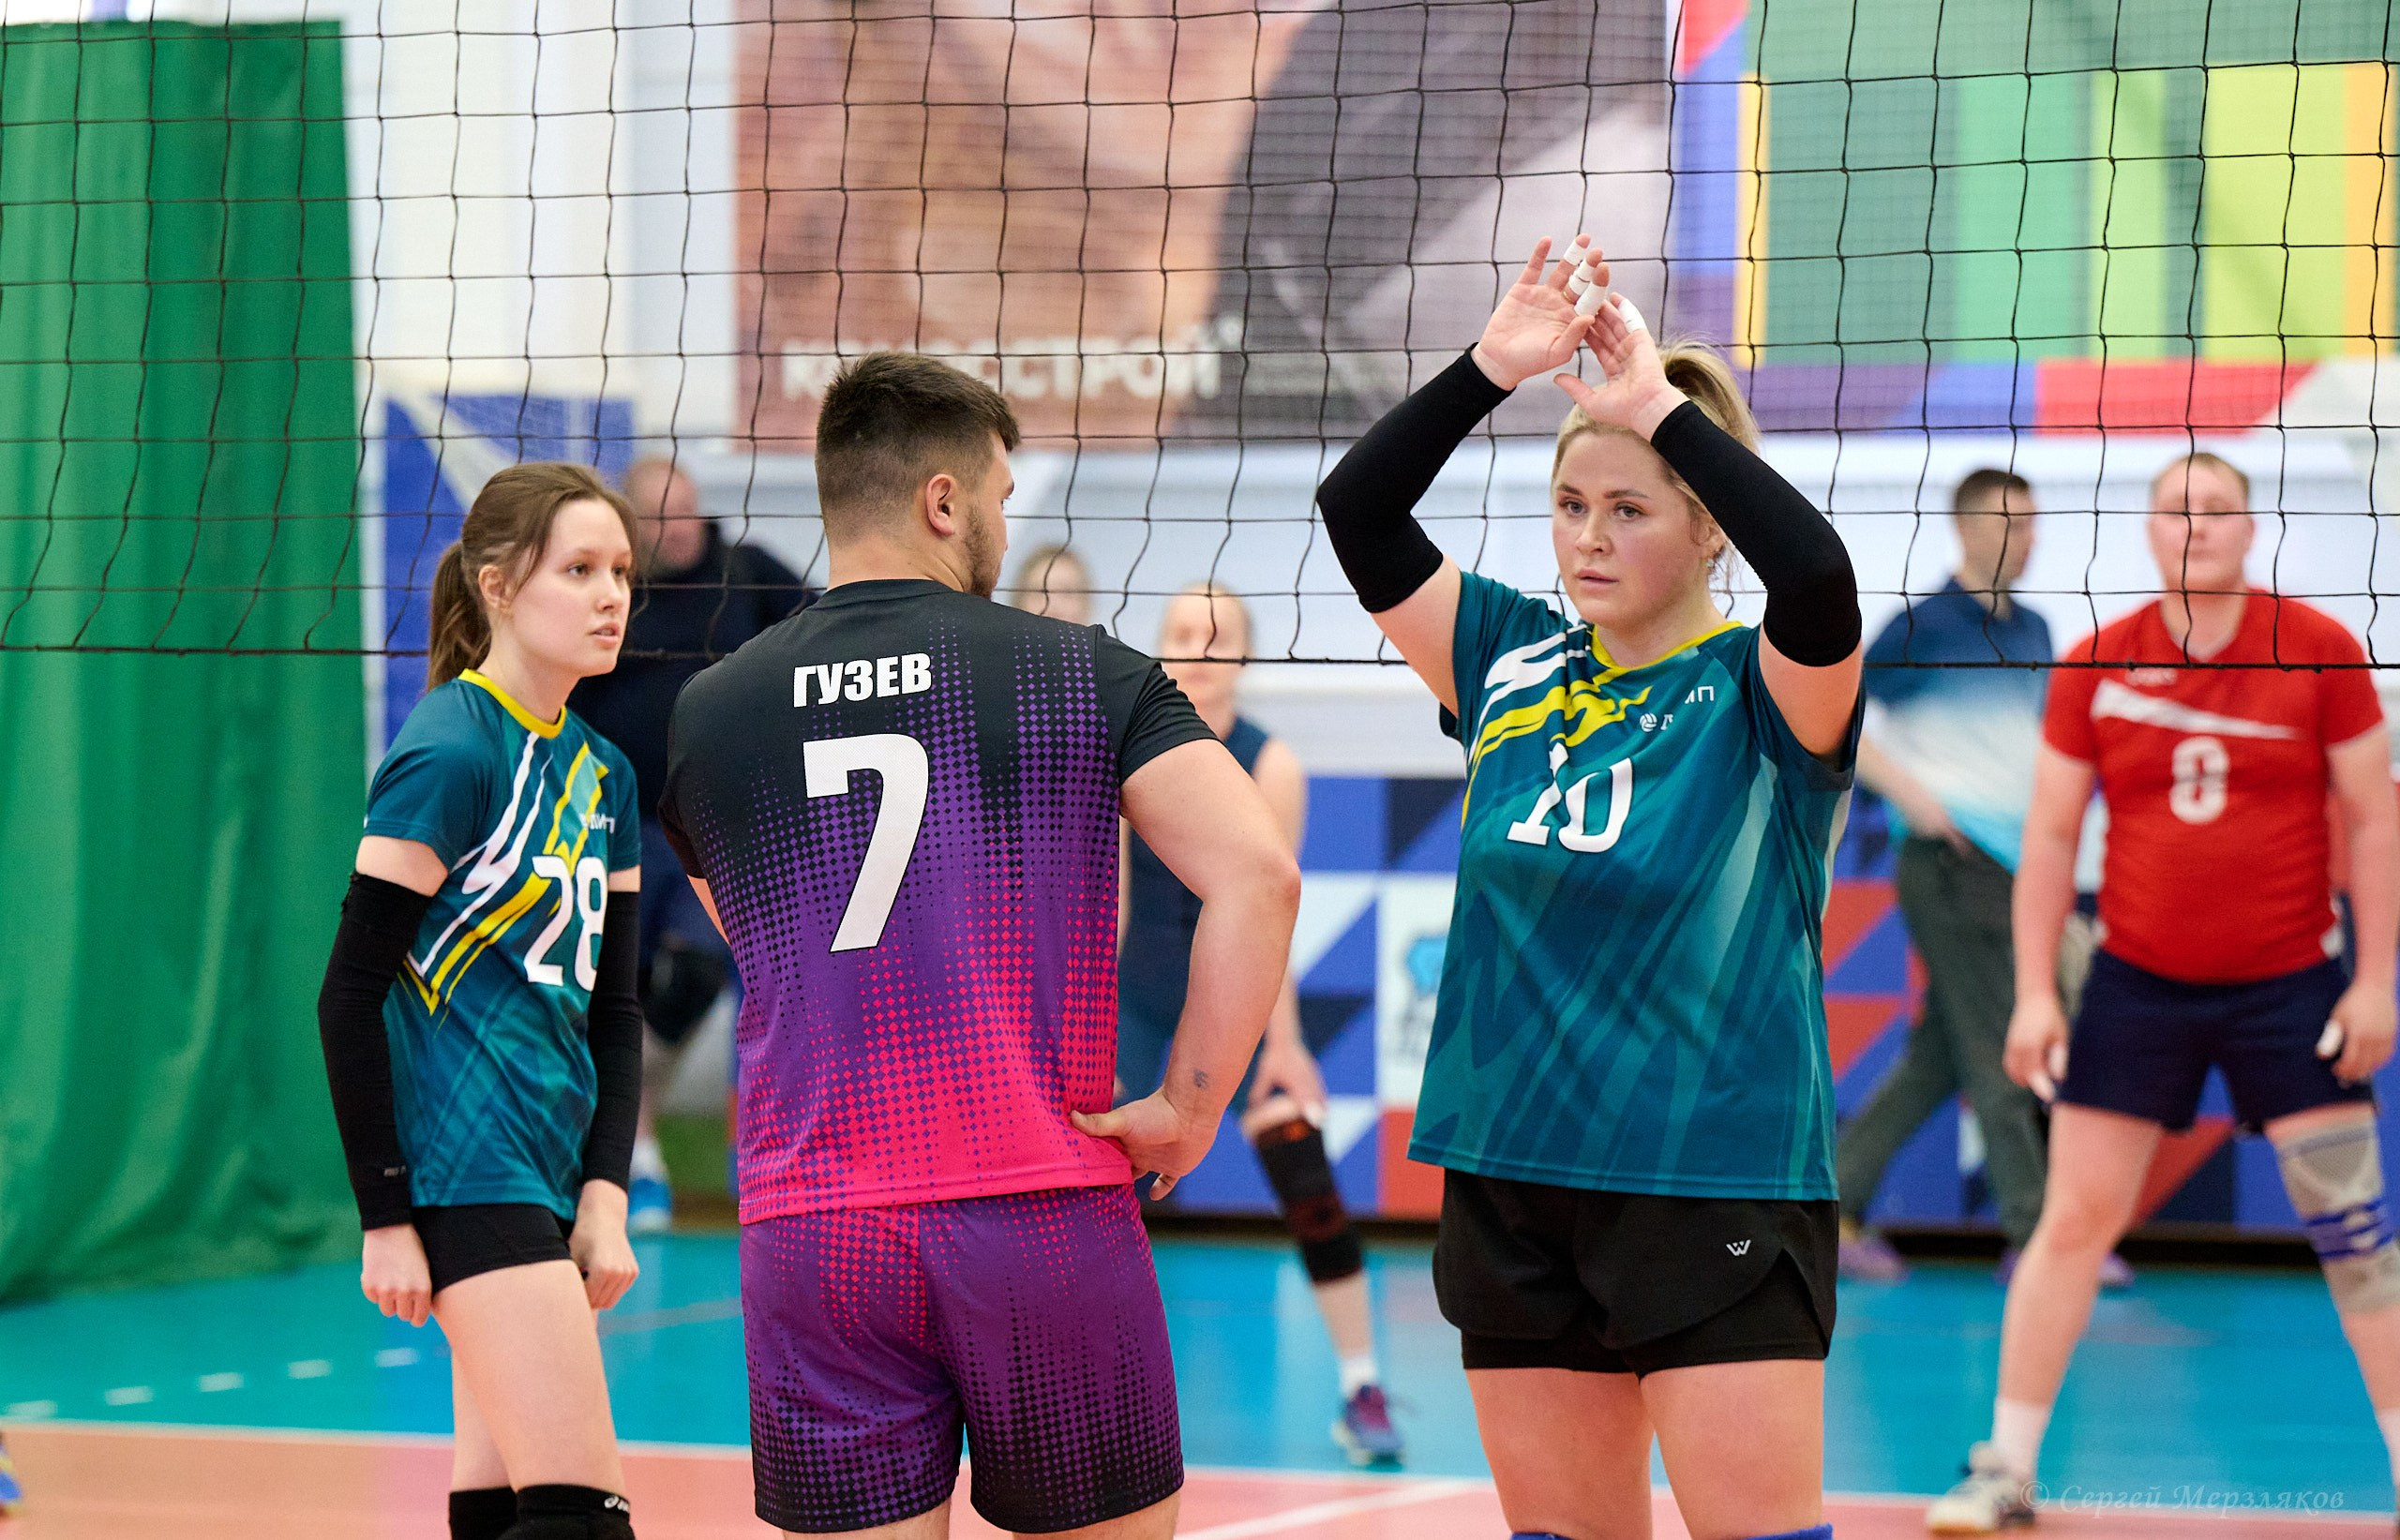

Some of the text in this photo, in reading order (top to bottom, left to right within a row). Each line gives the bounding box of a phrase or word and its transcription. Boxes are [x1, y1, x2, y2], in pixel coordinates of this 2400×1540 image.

[793, 653, 932, 708] ГУЗЕВ
[802, 733, 930, 952] 7
[1507, 742, 1633, 853] 10
[523, 856, 608, 992] 28
